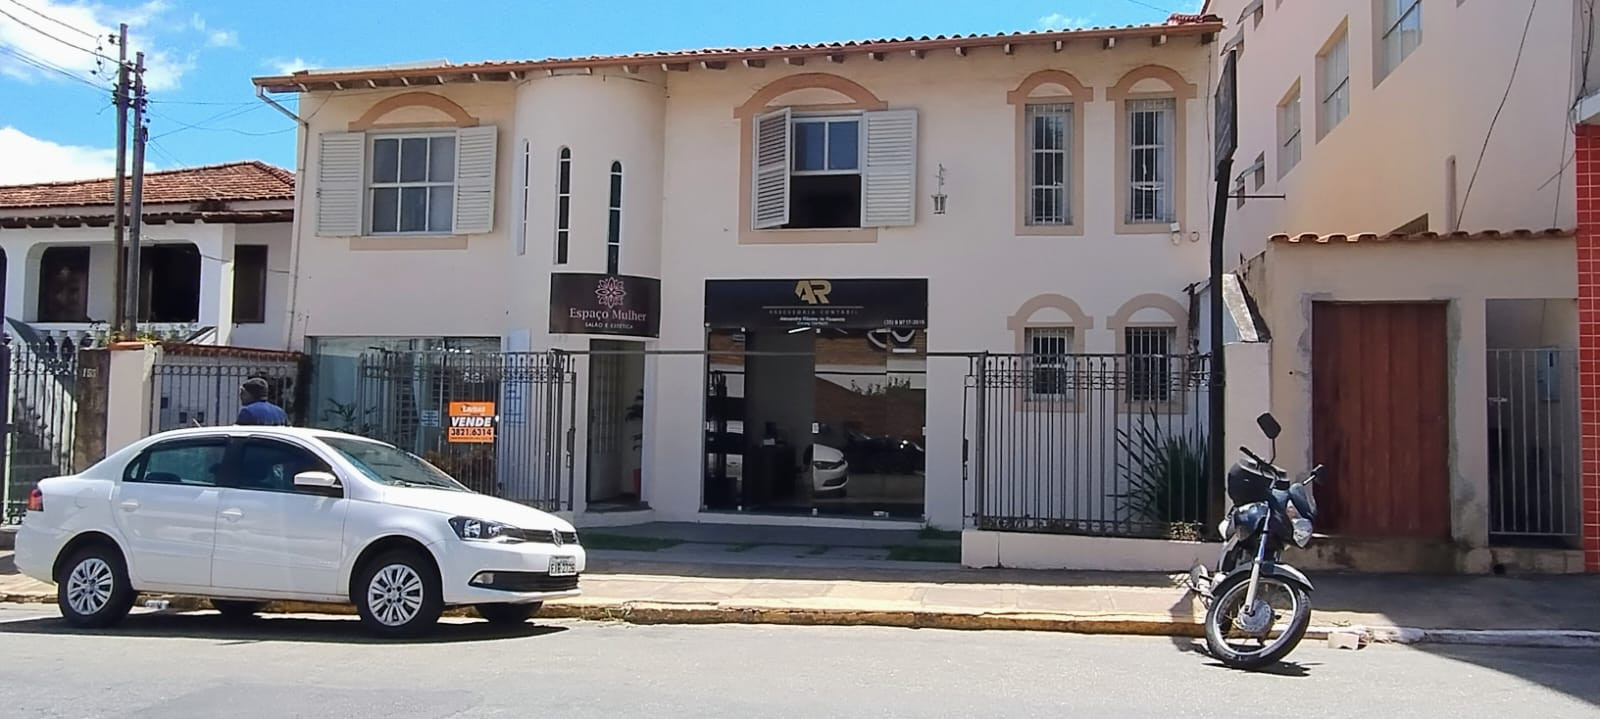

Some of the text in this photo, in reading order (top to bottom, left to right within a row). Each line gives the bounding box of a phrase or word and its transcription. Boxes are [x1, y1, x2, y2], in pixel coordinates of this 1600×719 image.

[795, 280, 832, 304] AR
[569, 307, 647, 321] Espaço Mulher
[451, 416, 492, 427] VENDE
[450, 428, 492, 436] 3821.6314
